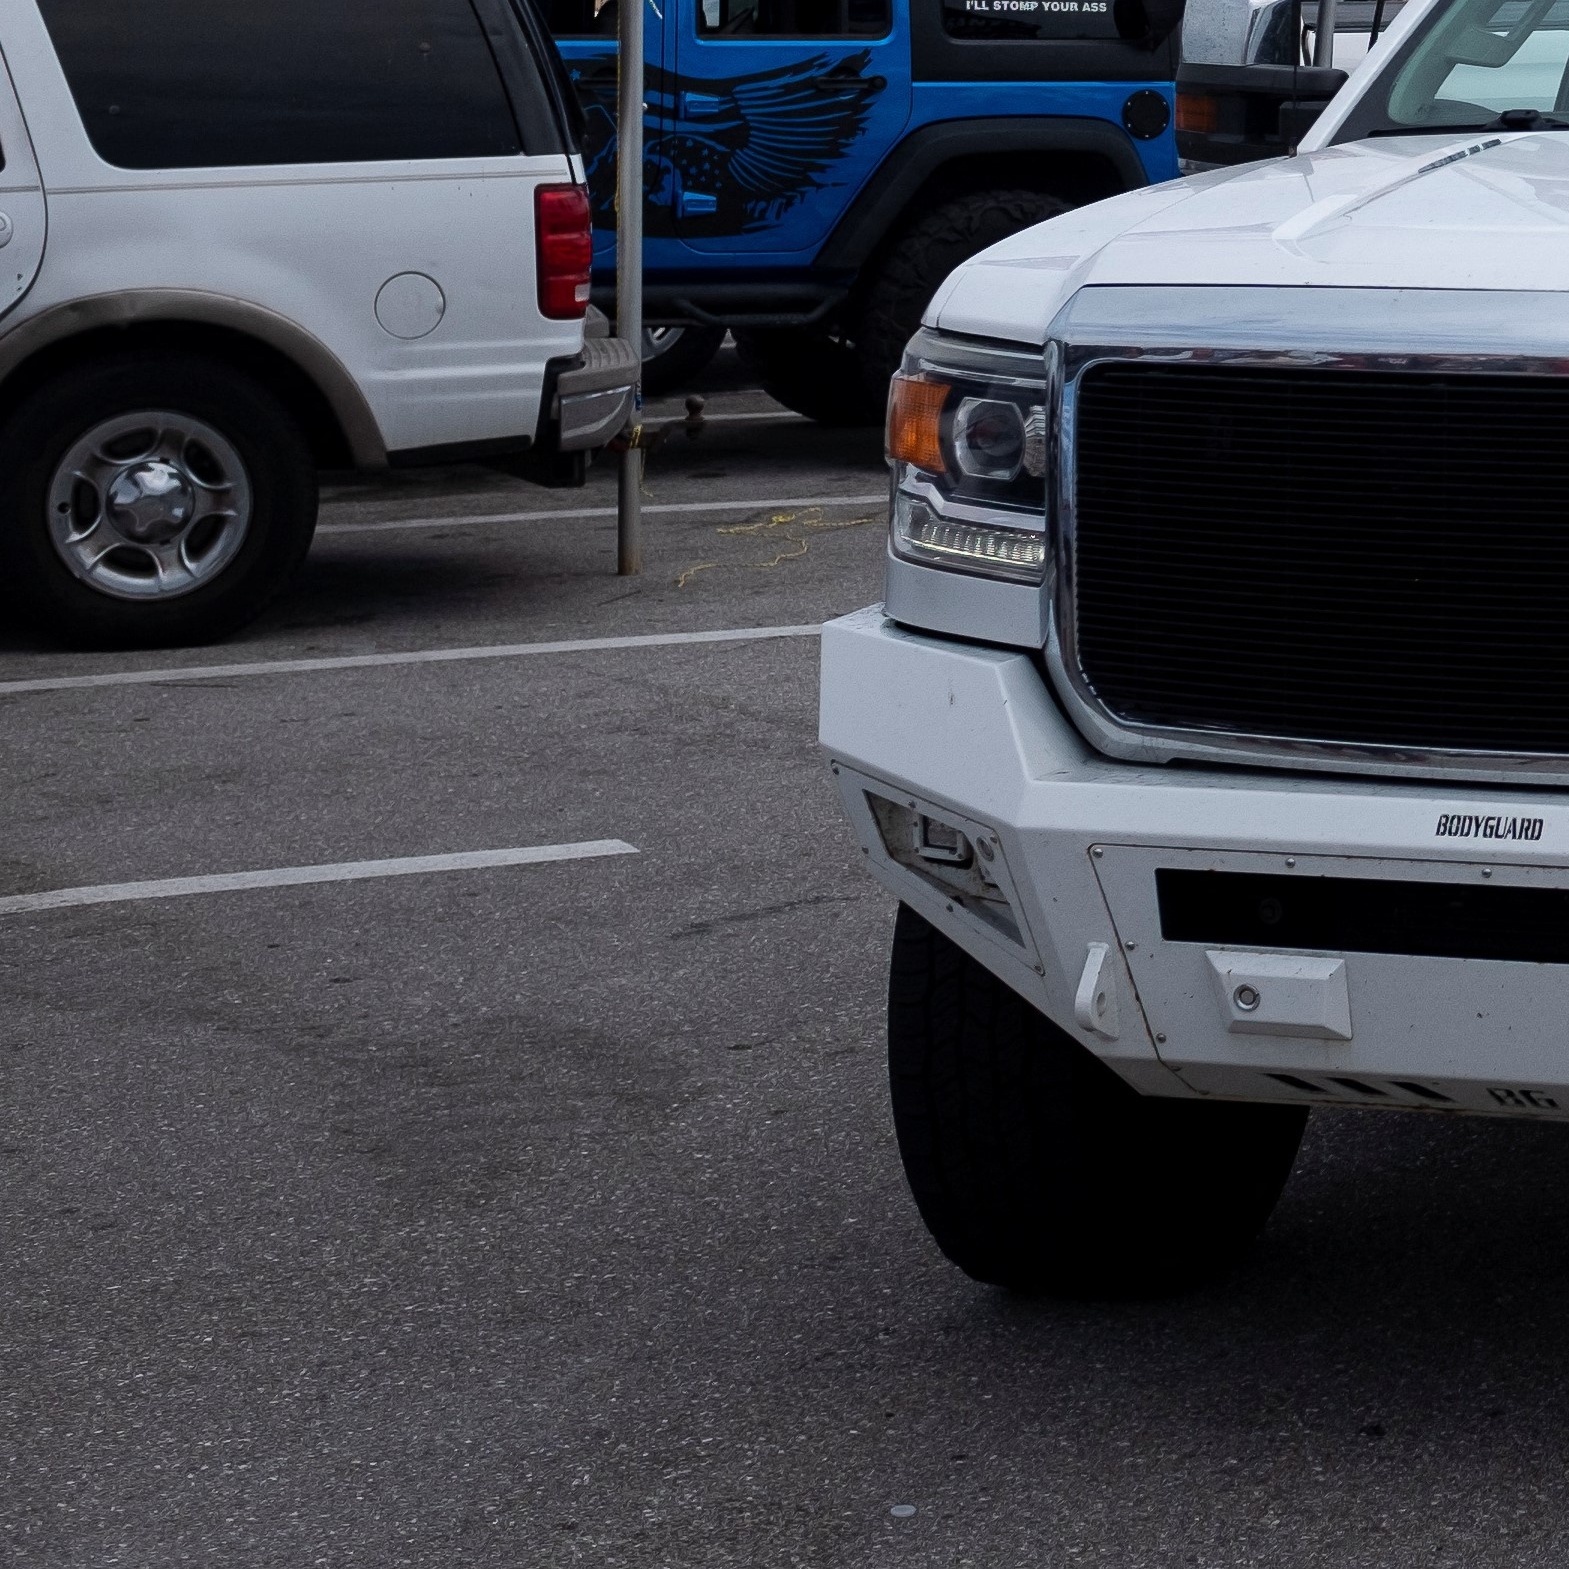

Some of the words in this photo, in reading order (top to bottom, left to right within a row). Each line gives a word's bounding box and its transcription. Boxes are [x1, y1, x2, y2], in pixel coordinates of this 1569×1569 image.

[965, 0, 990, 12] I'LL
[993, 0, 1040, 12] STOMP
[1042, 1, 1080, 13] YOUR
[1081, 2, 1108, 14] ASS
[1435, 813, 1544, 842] BODYGUARD
